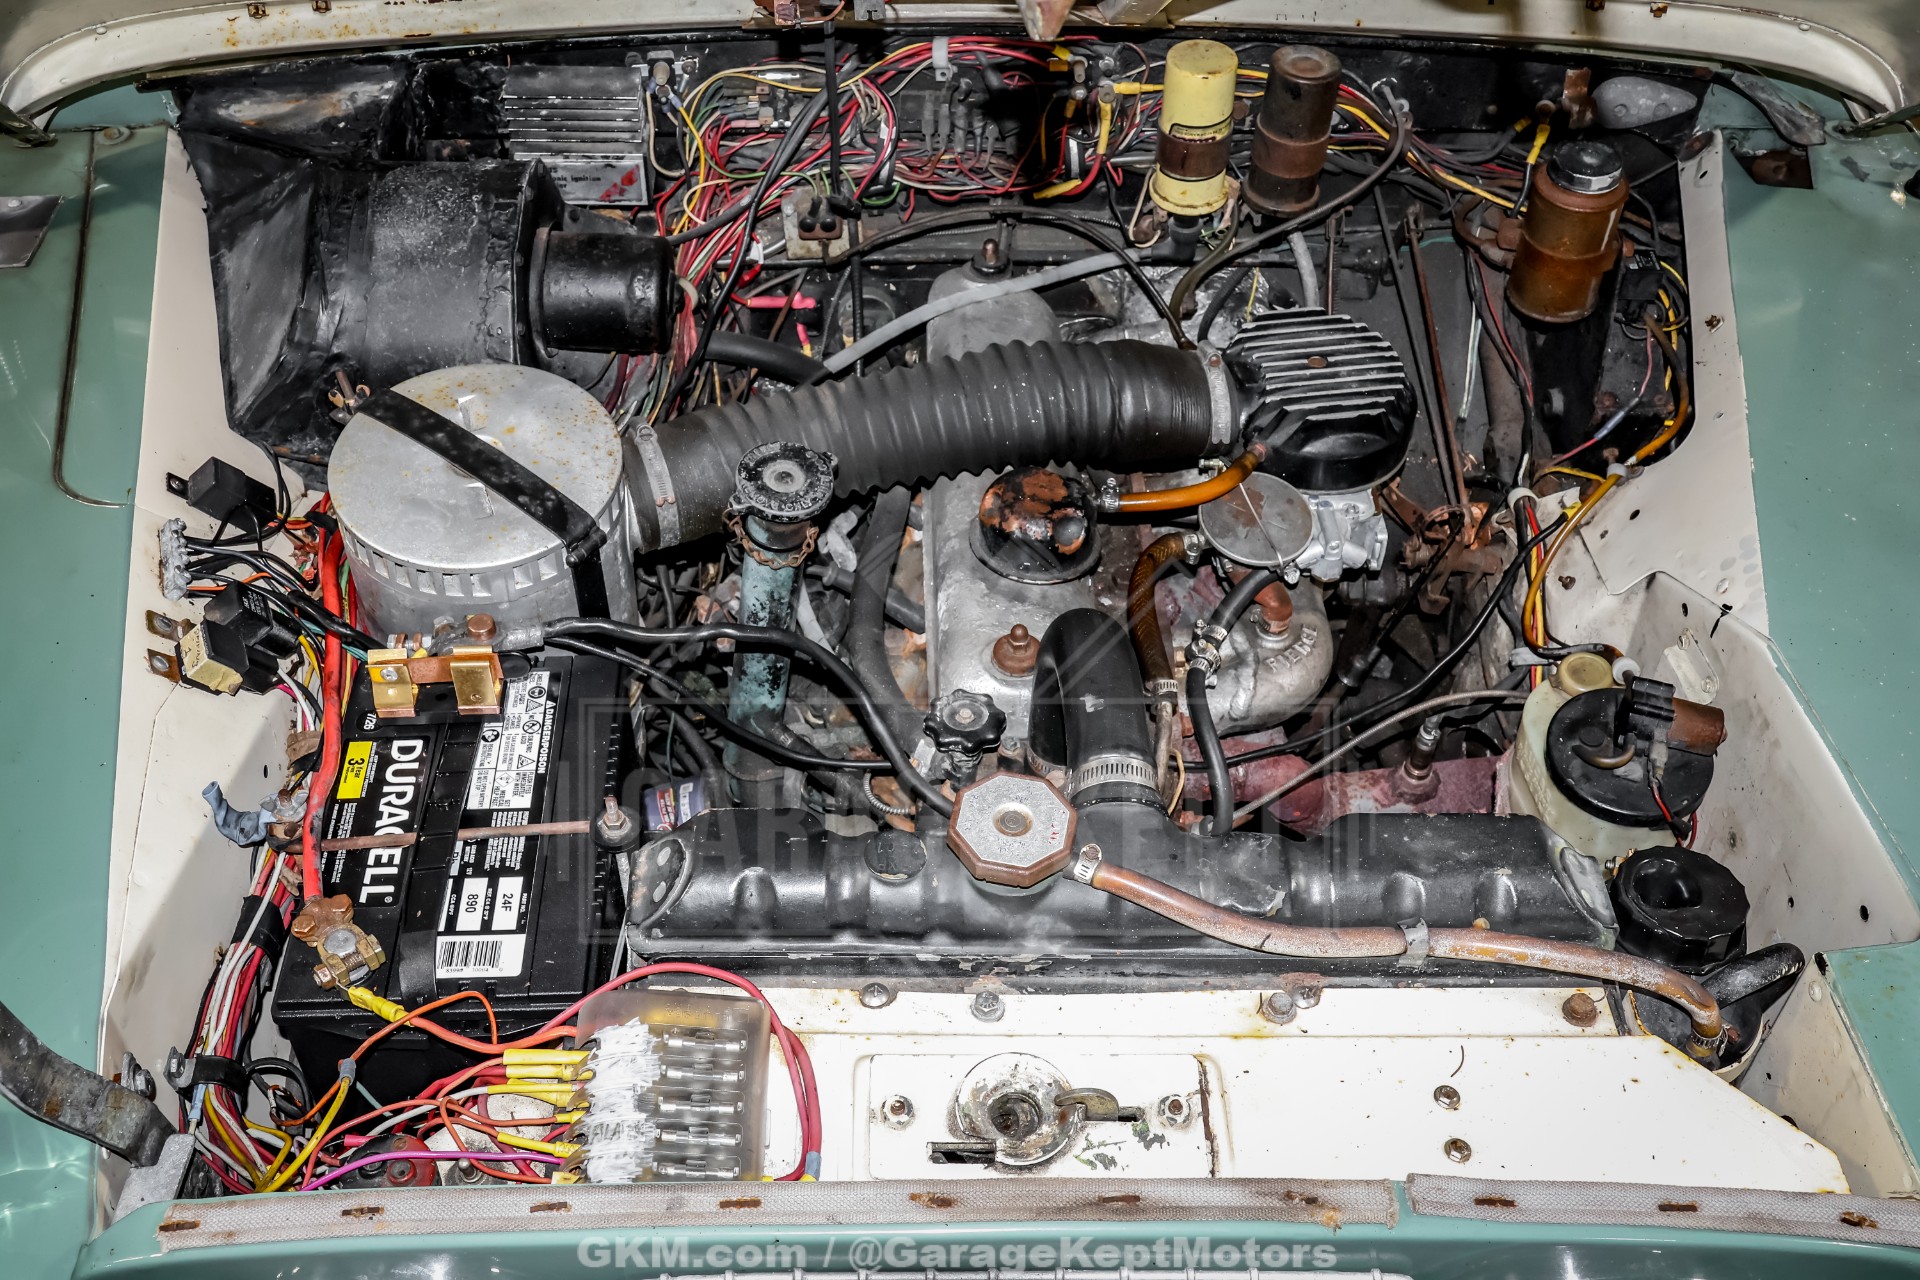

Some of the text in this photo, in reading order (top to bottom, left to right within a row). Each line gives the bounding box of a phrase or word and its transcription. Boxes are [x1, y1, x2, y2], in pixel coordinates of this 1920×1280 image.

[537, 709, 554, 774] DANGER/POISON
[348, 758, 365, 766] 3
[466, 894, 478, 912] 890
[501, 893, 513, 912] 24F
